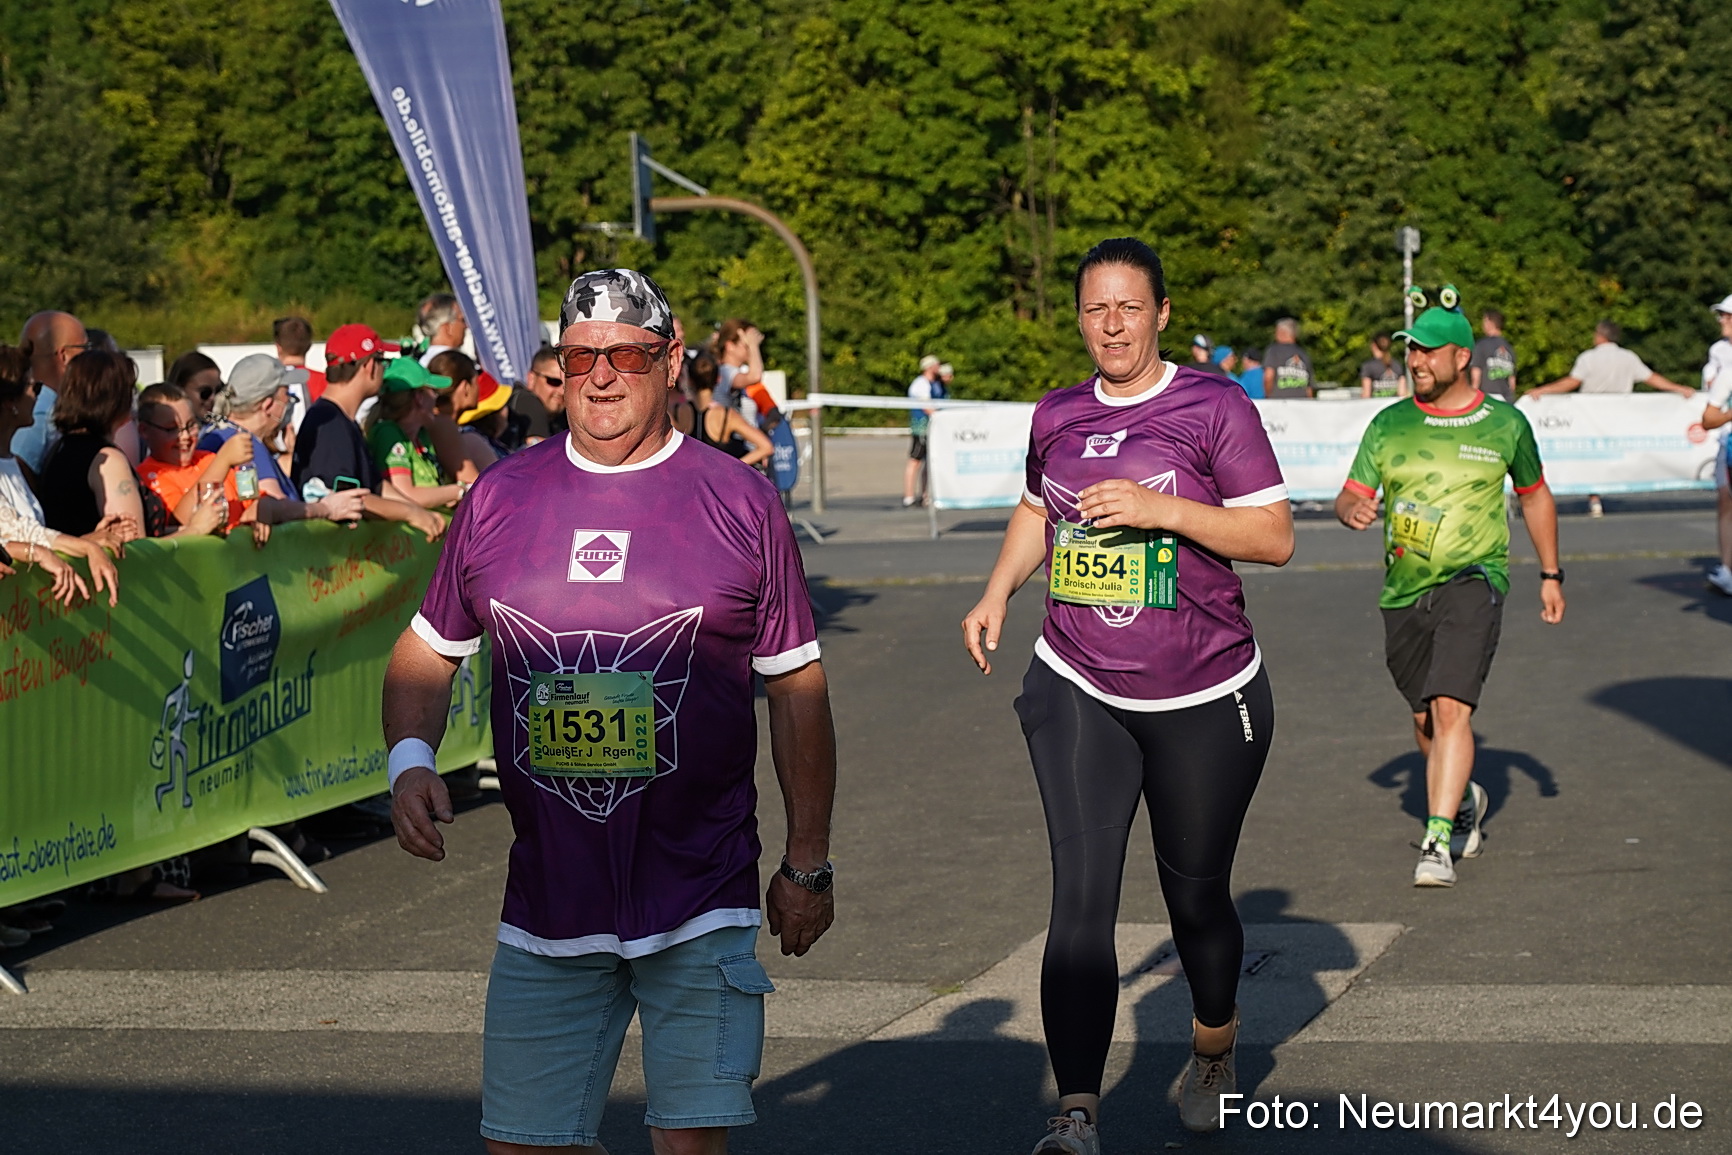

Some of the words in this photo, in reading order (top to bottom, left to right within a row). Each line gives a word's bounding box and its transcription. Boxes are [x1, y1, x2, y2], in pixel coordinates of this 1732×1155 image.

[1404, 517, 1419, 536] 91
[574, 550, 624, 560] FUCHS
[1054, 551, 1062, 588] WALK
[1063, 550, 1127, 579] 1554
[1064, 577, 1096, 590] Broisch
[1098, 581, 1122, 591] Julia
[1130, 559, 1140, 595] 2022
[49, 608, 112, 687] länger!
[197, 648, 318, 770] firmenlauf
[550, 691, 591, 701] Firmenlauf
[533, 711, 543, 760] WALK
[543, 708, 626, 744] 1531
[634, 713, 648, 761] 2022
[1238, 703, 1254, 743] TERREX
[586, 746, 593, 758] J
[602, 746, 636, 759] Rgen
